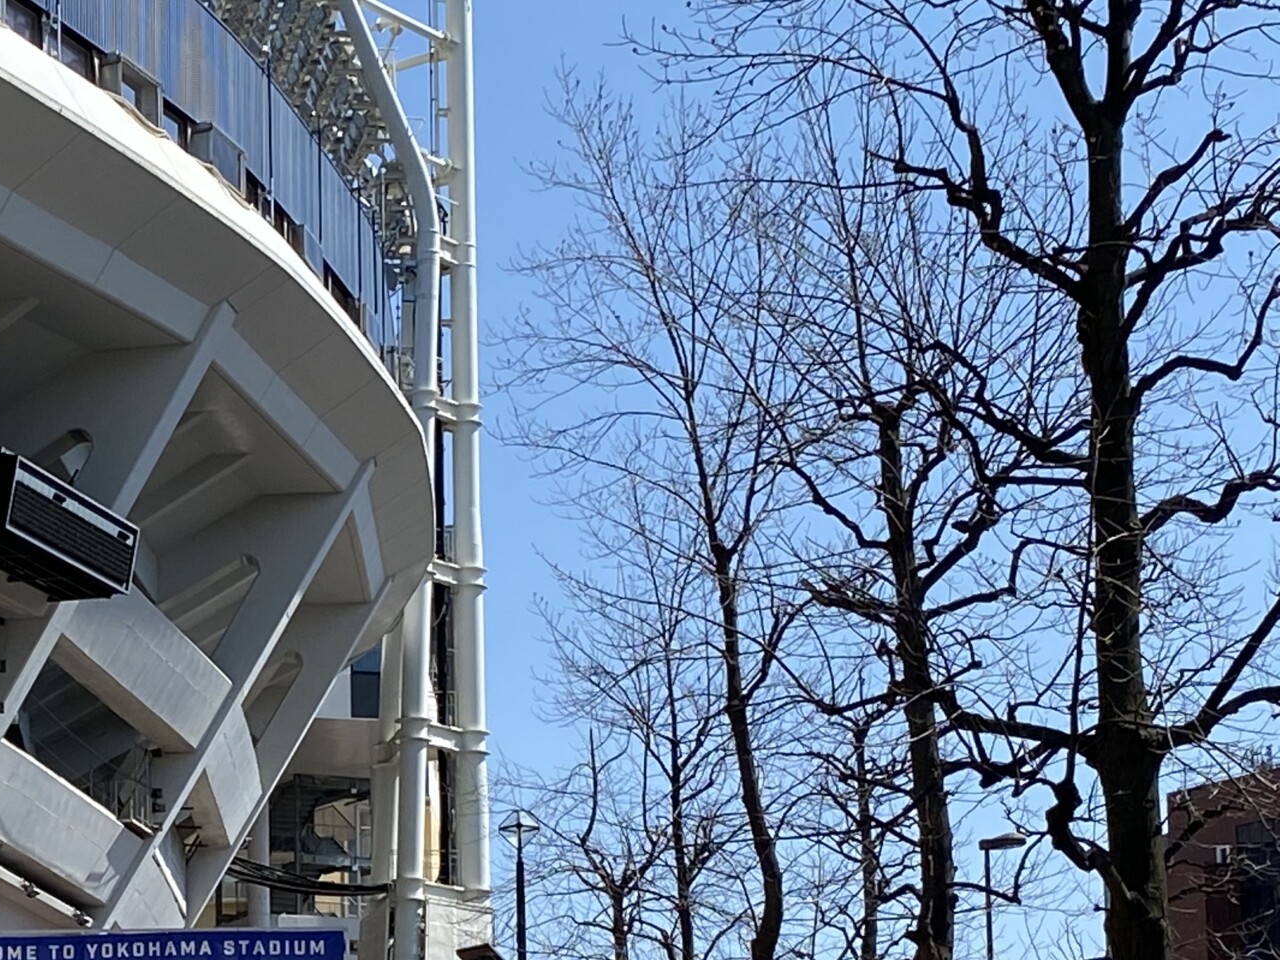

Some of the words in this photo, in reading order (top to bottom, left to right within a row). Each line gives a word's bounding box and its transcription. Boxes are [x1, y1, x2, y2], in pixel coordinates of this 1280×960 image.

[48, 944, 75, 960] TO
[86, 940, 212, 959] YOKOHAMA
[223, 939, 325, 956] STADIUM
